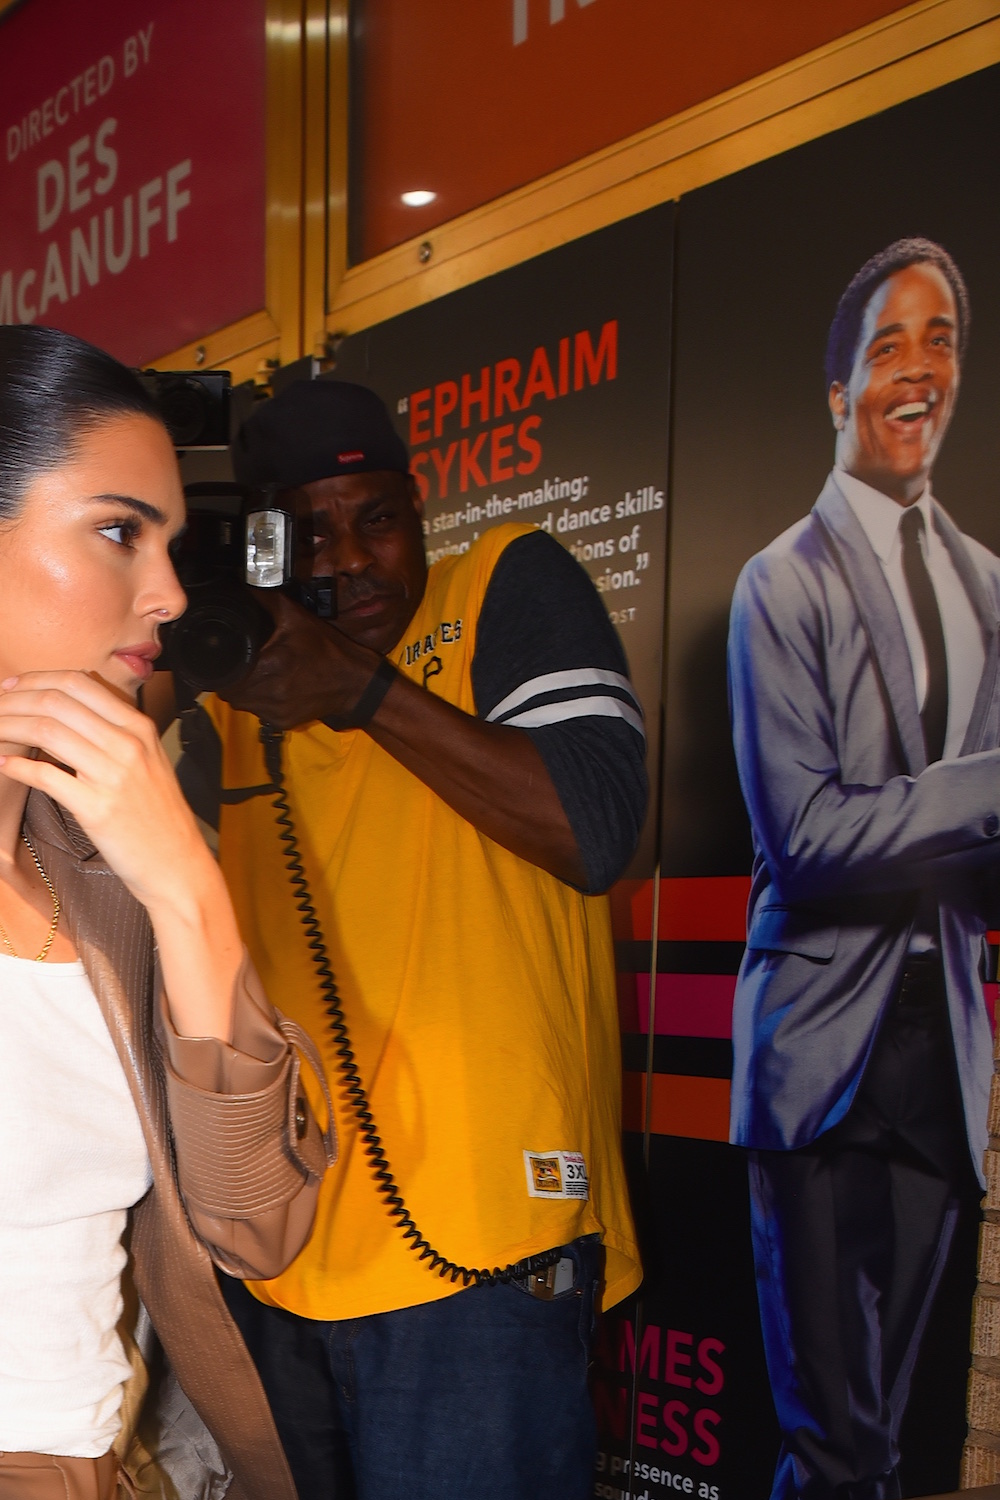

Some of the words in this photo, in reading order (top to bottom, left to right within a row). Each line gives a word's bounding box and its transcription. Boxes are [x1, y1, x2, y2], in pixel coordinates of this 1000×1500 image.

[6, 54, 114, 163] DIRECTED
[123, 22, 155, 78] BY
[37, 117, 119, 233] DES
[409, 414, 542, 501] SYKES
[432, 475, 590, 533] star-in-the-making;
[556, 504, 611, 533] dance
[615, 486, 665, 519] skills
[619, 525, 641, 551] of
[604, 1318, 727, 1397] MES
